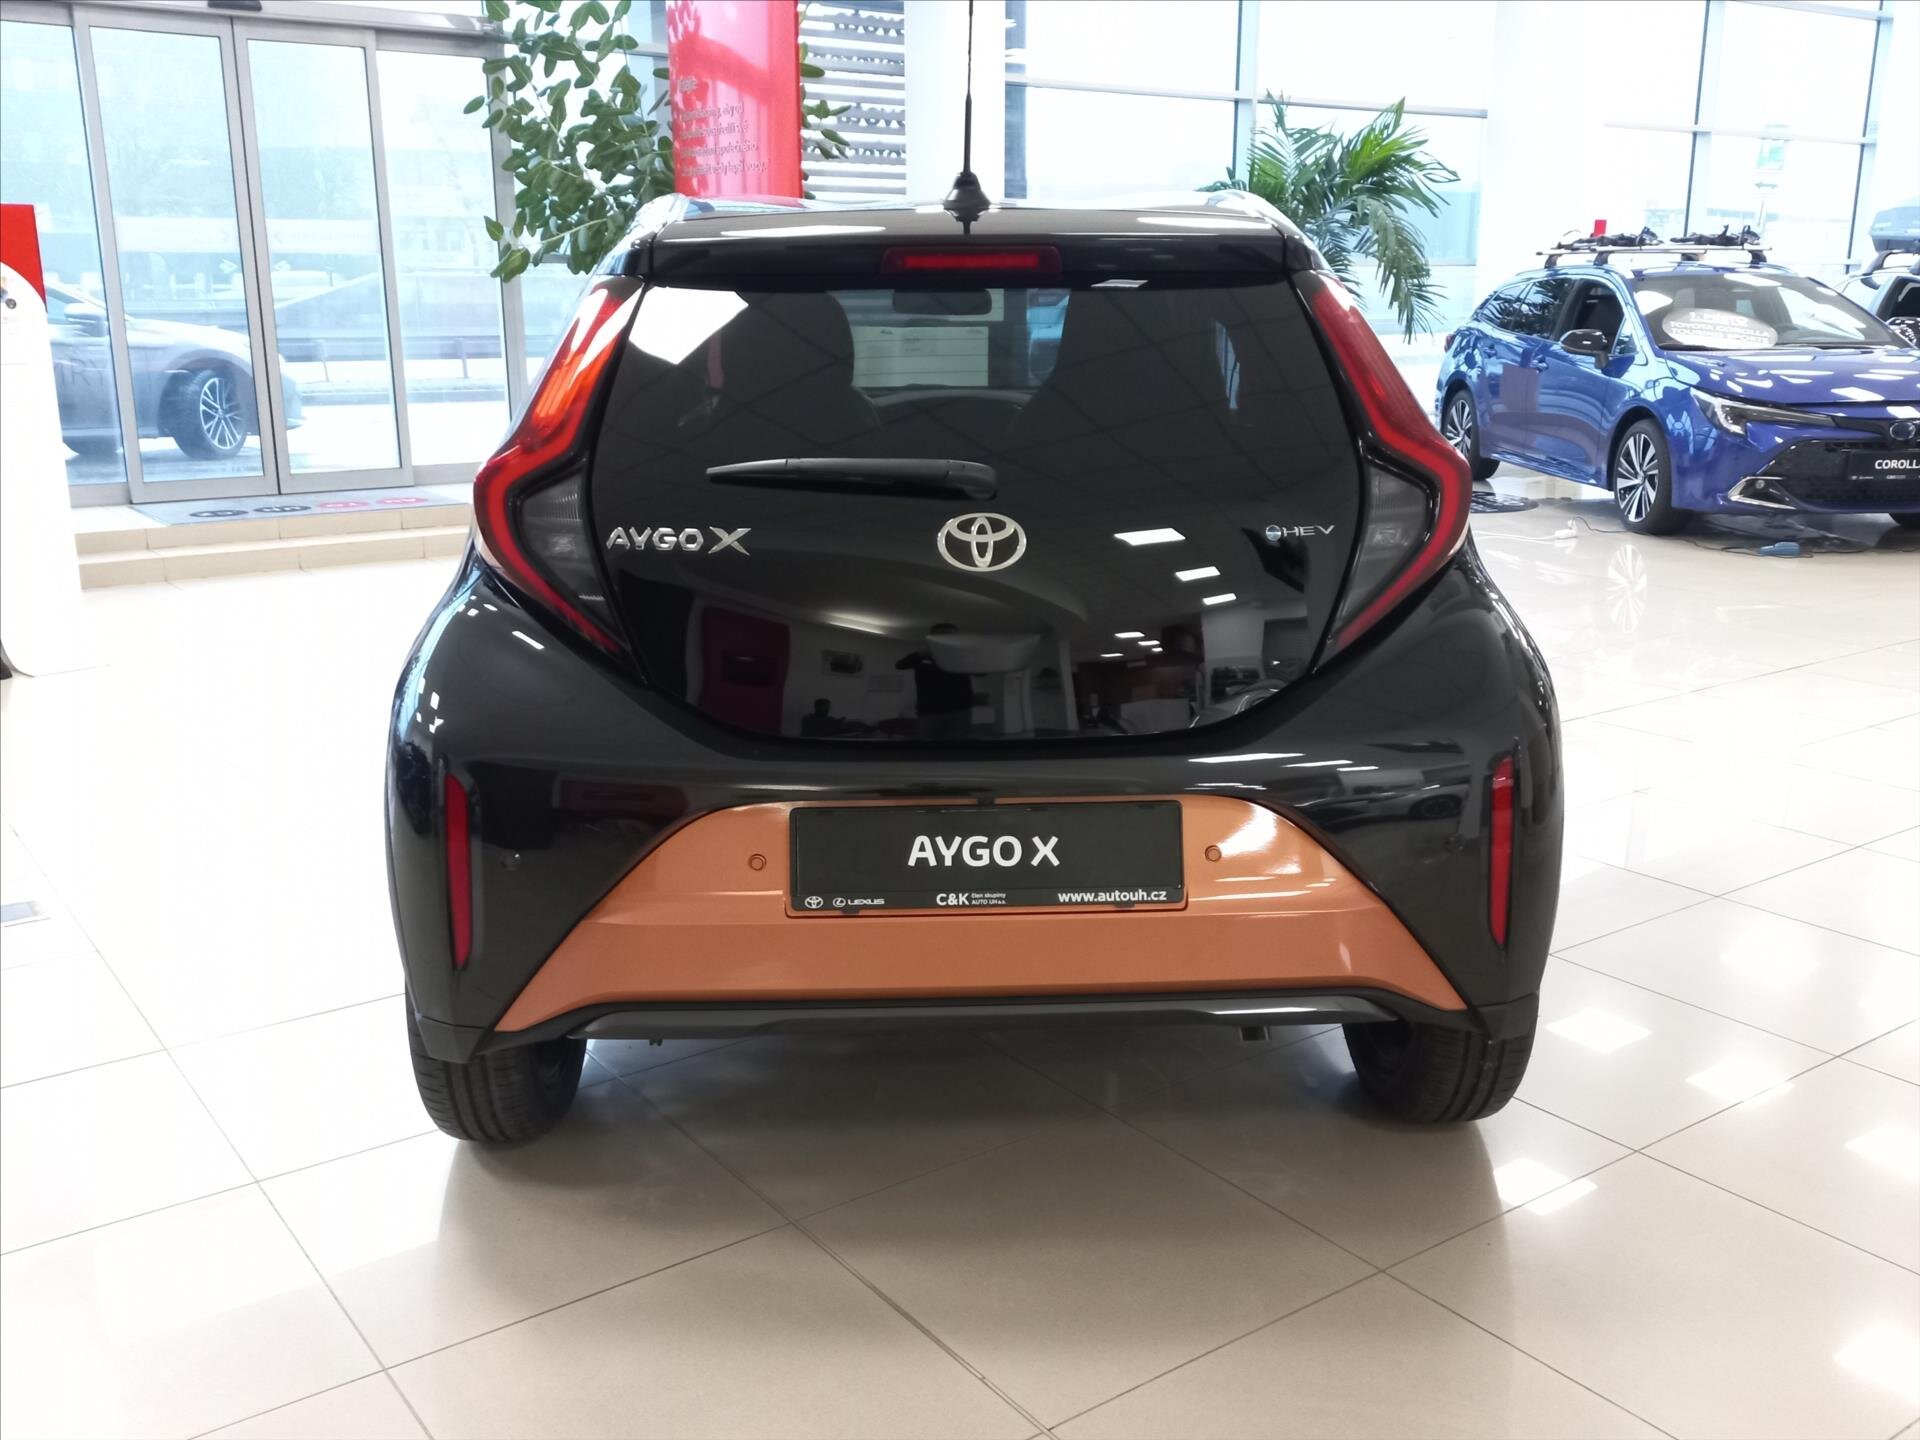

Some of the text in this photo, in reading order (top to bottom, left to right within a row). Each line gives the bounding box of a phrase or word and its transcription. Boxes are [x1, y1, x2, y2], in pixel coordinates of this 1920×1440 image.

[1874, 459, 1920, 470] COROLL
[1282, 525, 1335, 537] HEV
[606, 526, 752, 556] AYGO X
[907, 834, 1061, 868] AYGO X
[847, 898, 885, 906] LEXUS
[936, 893, 970, 906] C&K
[1058, 889, 1168, 903] www.autouh.cz
